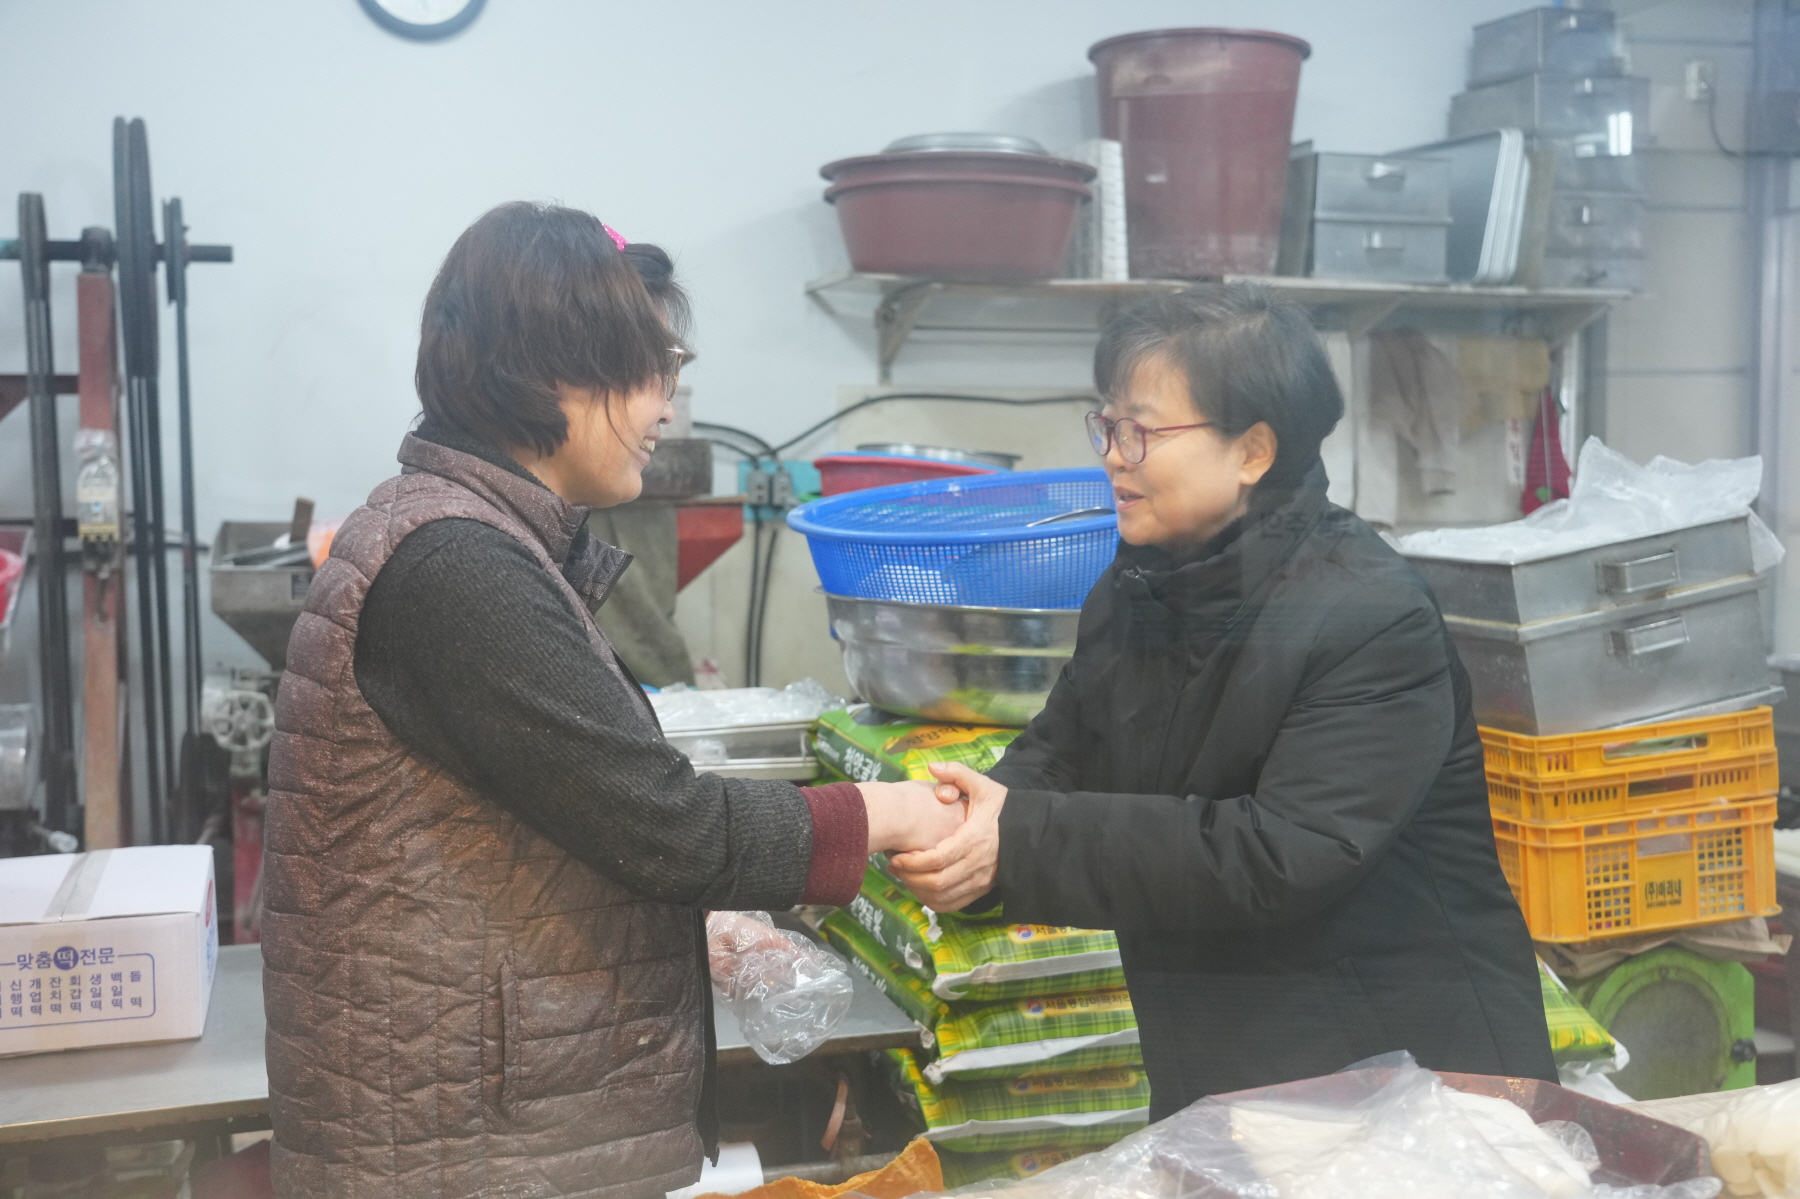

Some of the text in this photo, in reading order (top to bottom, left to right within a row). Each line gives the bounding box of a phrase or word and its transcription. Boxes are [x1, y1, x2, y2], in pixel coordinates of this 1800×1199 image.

[30, 978, 42, 1015] 개업떡
[50, 976, 62, 1014] 잔치떡
[70, 975, 82, 1012] 회갑떡
[90, 973, 102, 1010] 생일떡
[111, 971, 123, 1009] 백일떡
